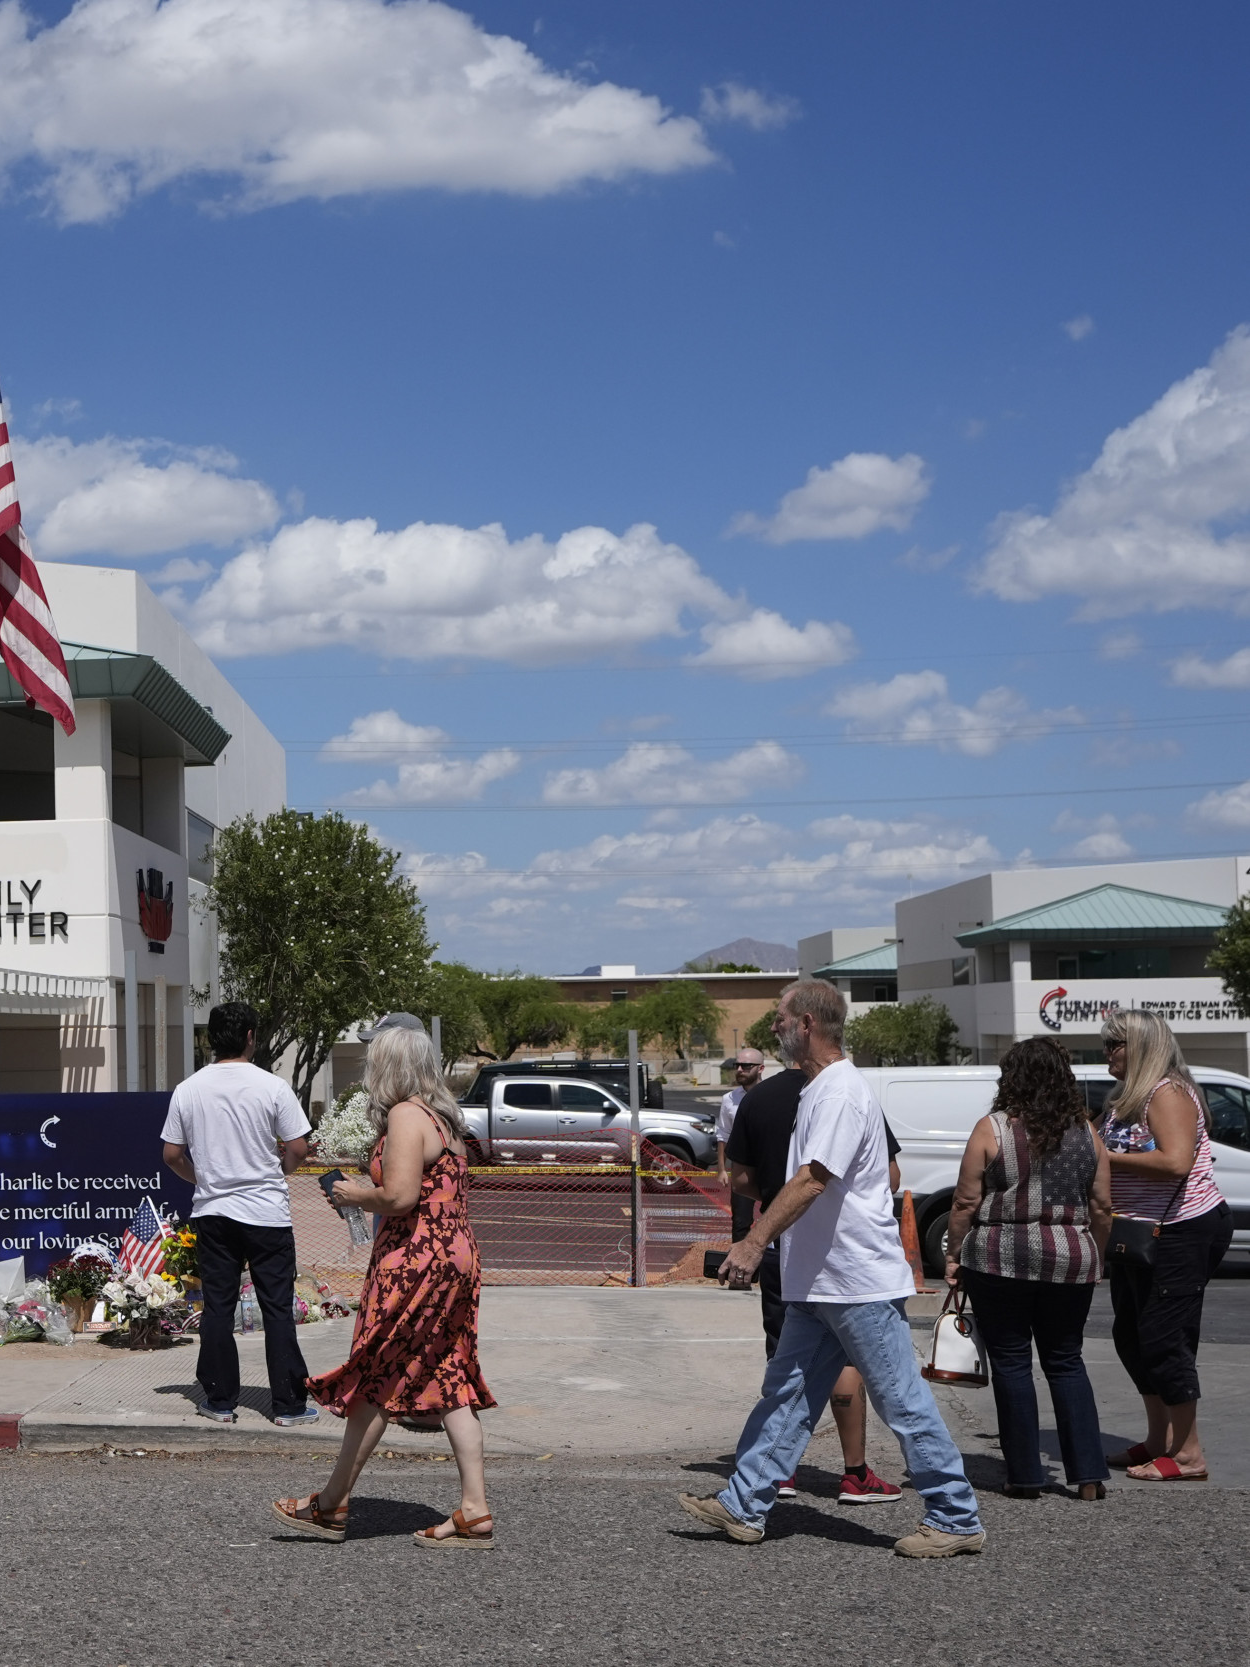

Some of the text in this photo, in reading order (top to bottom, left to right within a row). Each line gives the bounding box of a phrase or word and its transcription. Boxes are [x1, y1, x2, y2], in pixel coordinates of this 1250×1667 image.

[1055, 1000, 1119, 1011] TURNING
[1141, 1001, 1176, 1009] EDWARD
[1190, 1001, 1220, 1009] ZEMAN
[1056, 1009, 1098, 1021] POINT
[1157, 1010, 1202, 1020] GISTICS
[56, 1171, 80, 1190] be
[84, 1171, 161, 1190] received
[14, 1201, 91, 1220] merciful
[1, 1237, 35, 1250] our
